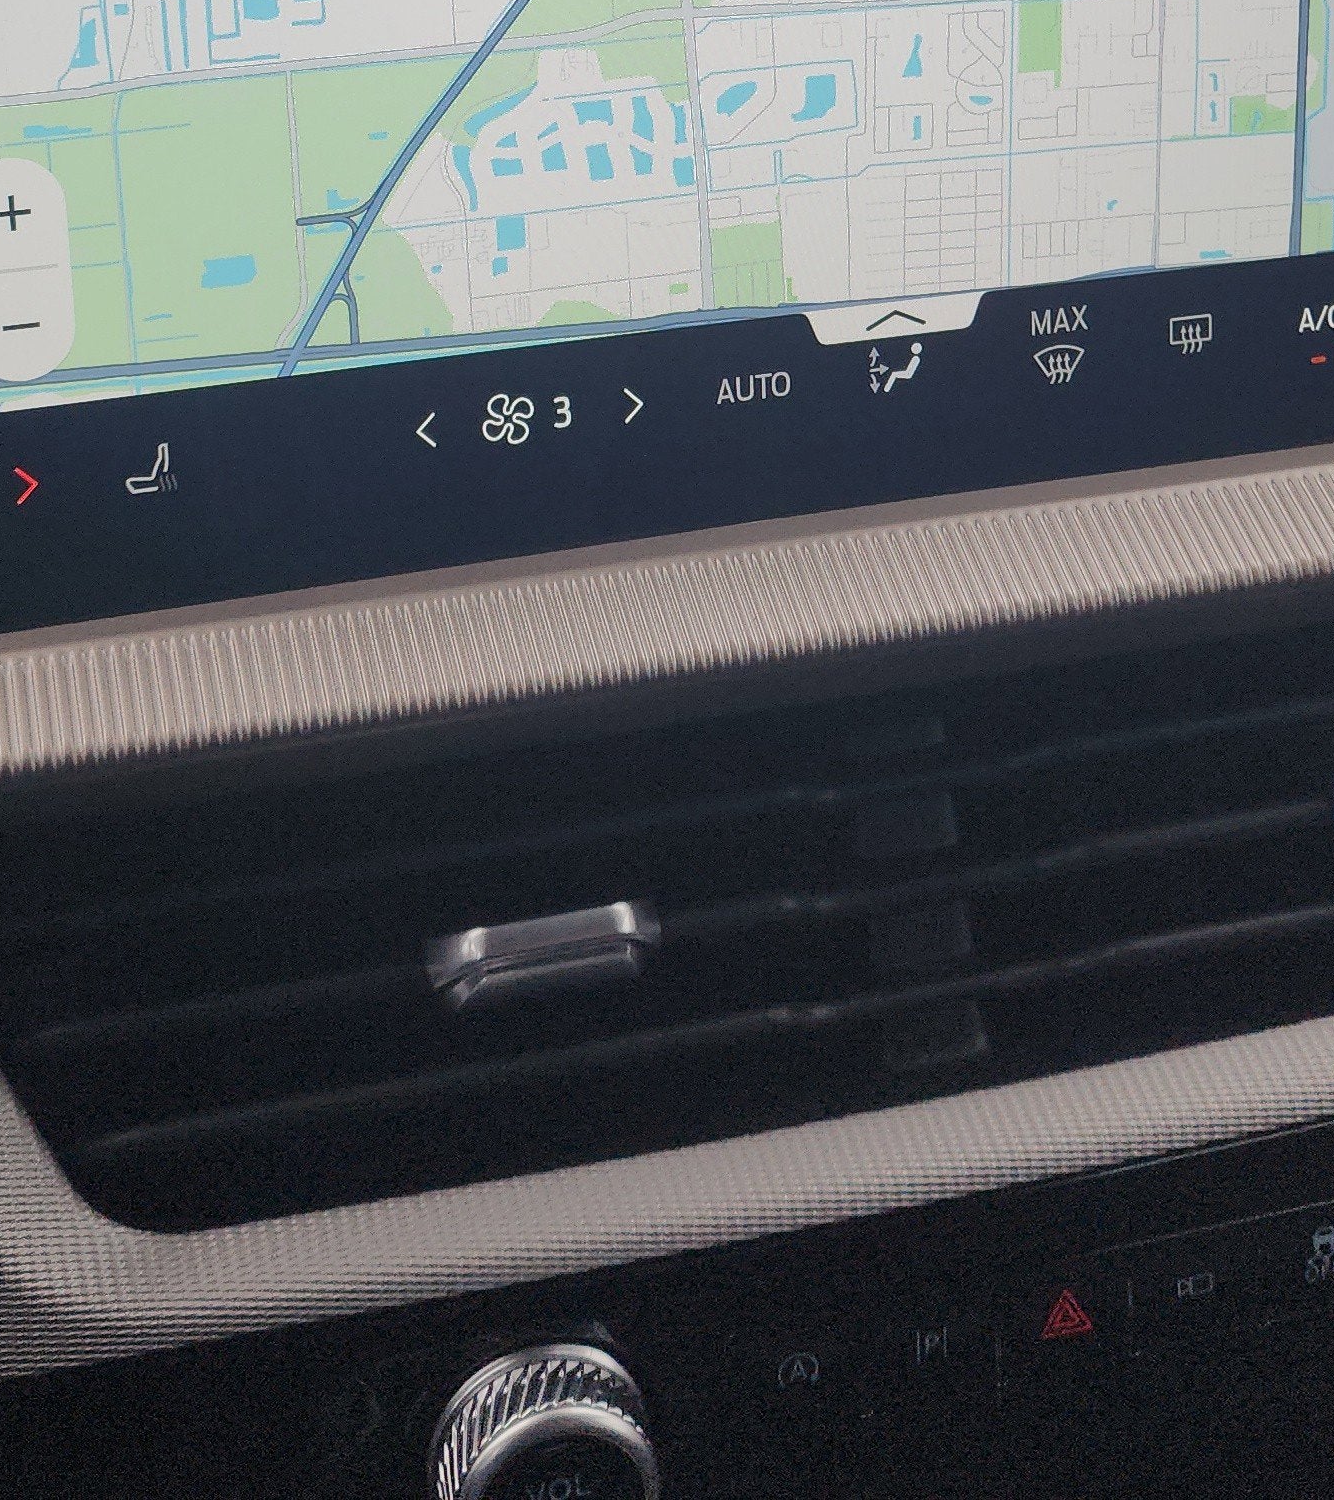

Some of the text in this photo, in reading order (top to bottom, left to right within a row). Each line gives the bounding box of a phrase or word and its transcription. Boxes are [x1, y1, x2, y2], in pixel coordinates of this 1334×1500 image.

[1030, 304, 1089, 337] MAX
[716, 371, 791, 405] AUTO
[553, 395, 572, 429] 3
